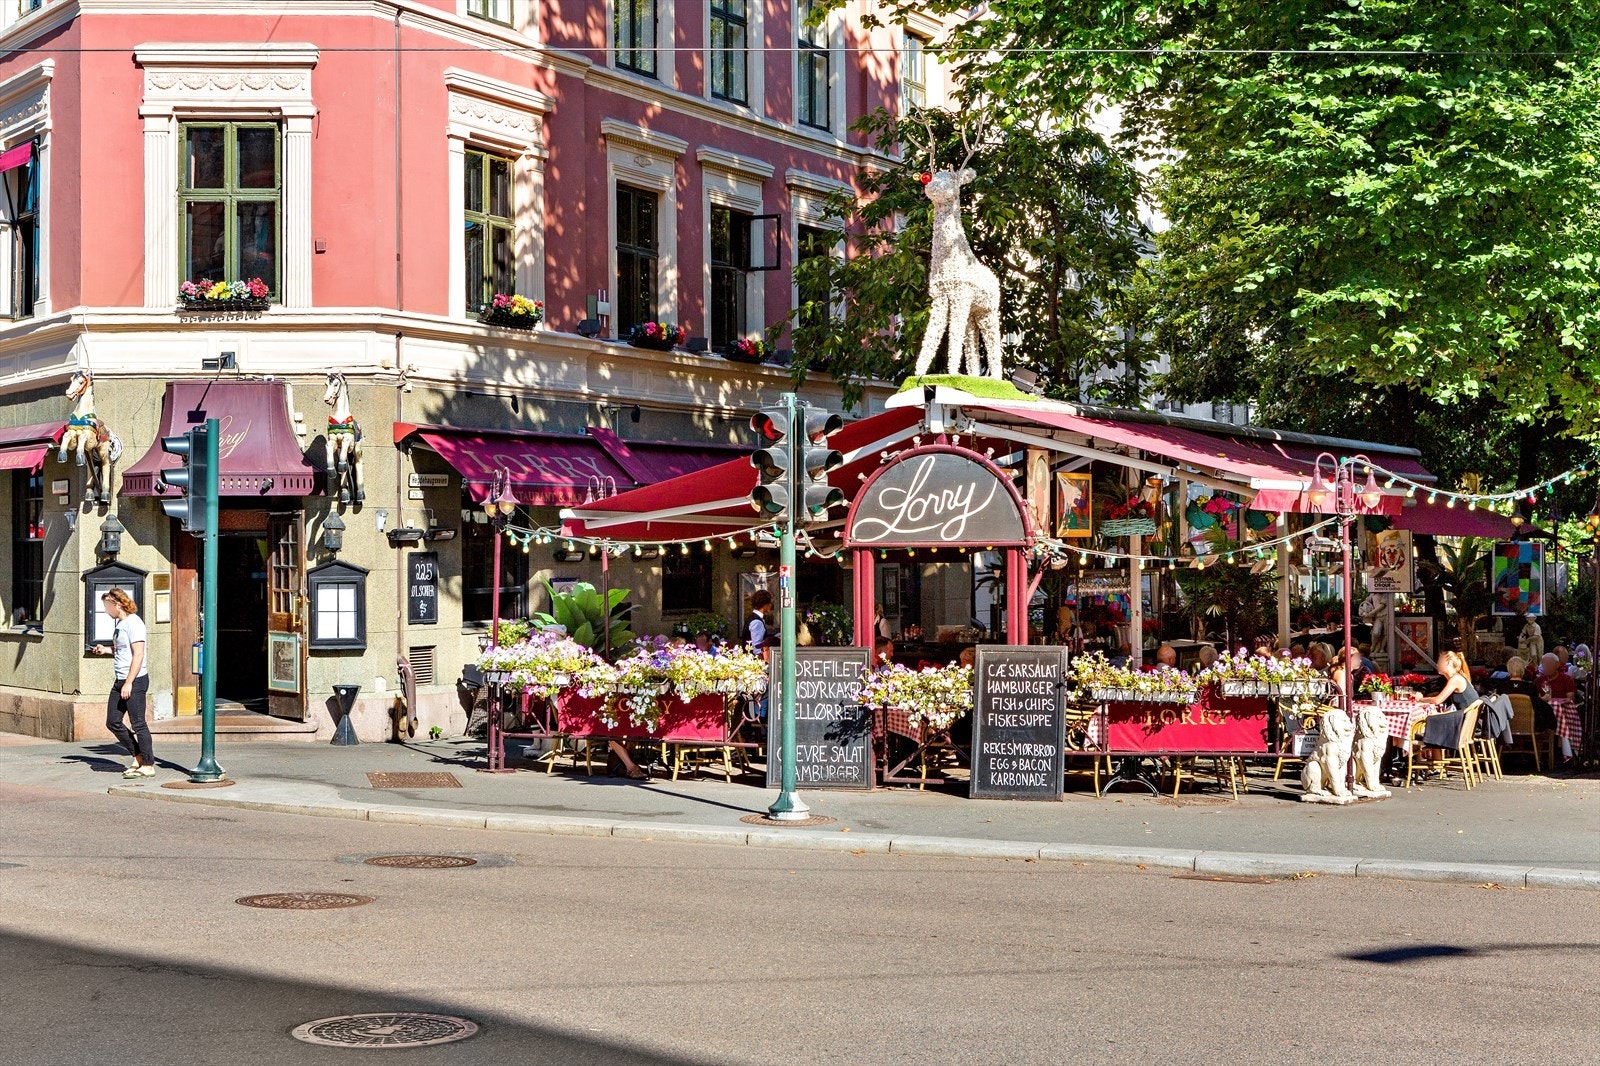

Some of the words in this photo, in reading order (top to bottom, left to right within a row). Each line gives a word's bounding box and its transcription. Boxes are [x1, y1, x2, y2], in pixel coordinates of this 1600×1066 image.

[461, 450, 608, 479] LORRY
[851, 455, 998, 543] Lorry
[415, 563, 433, 581] 225
[987, 680, 1054, 695] HAMBURGER
[992, 697, 1016, 711] FISH
[1024, 698, 1055, 712] CHIPS
[1145, 709, 1231, 726] LORRY
[776, 744, 828, 763] CEVRE
[830, 745, 864, 763] SALAT
[983, 742, 1056, 757] REKESMØRBRØD
[780, 764, 860, 782] AMBURGER
[990, 758, 1010, 770] EGG
[1019, 758, 1051, 772] BACON
[990, 772, 1047, 787] KARBONADE
